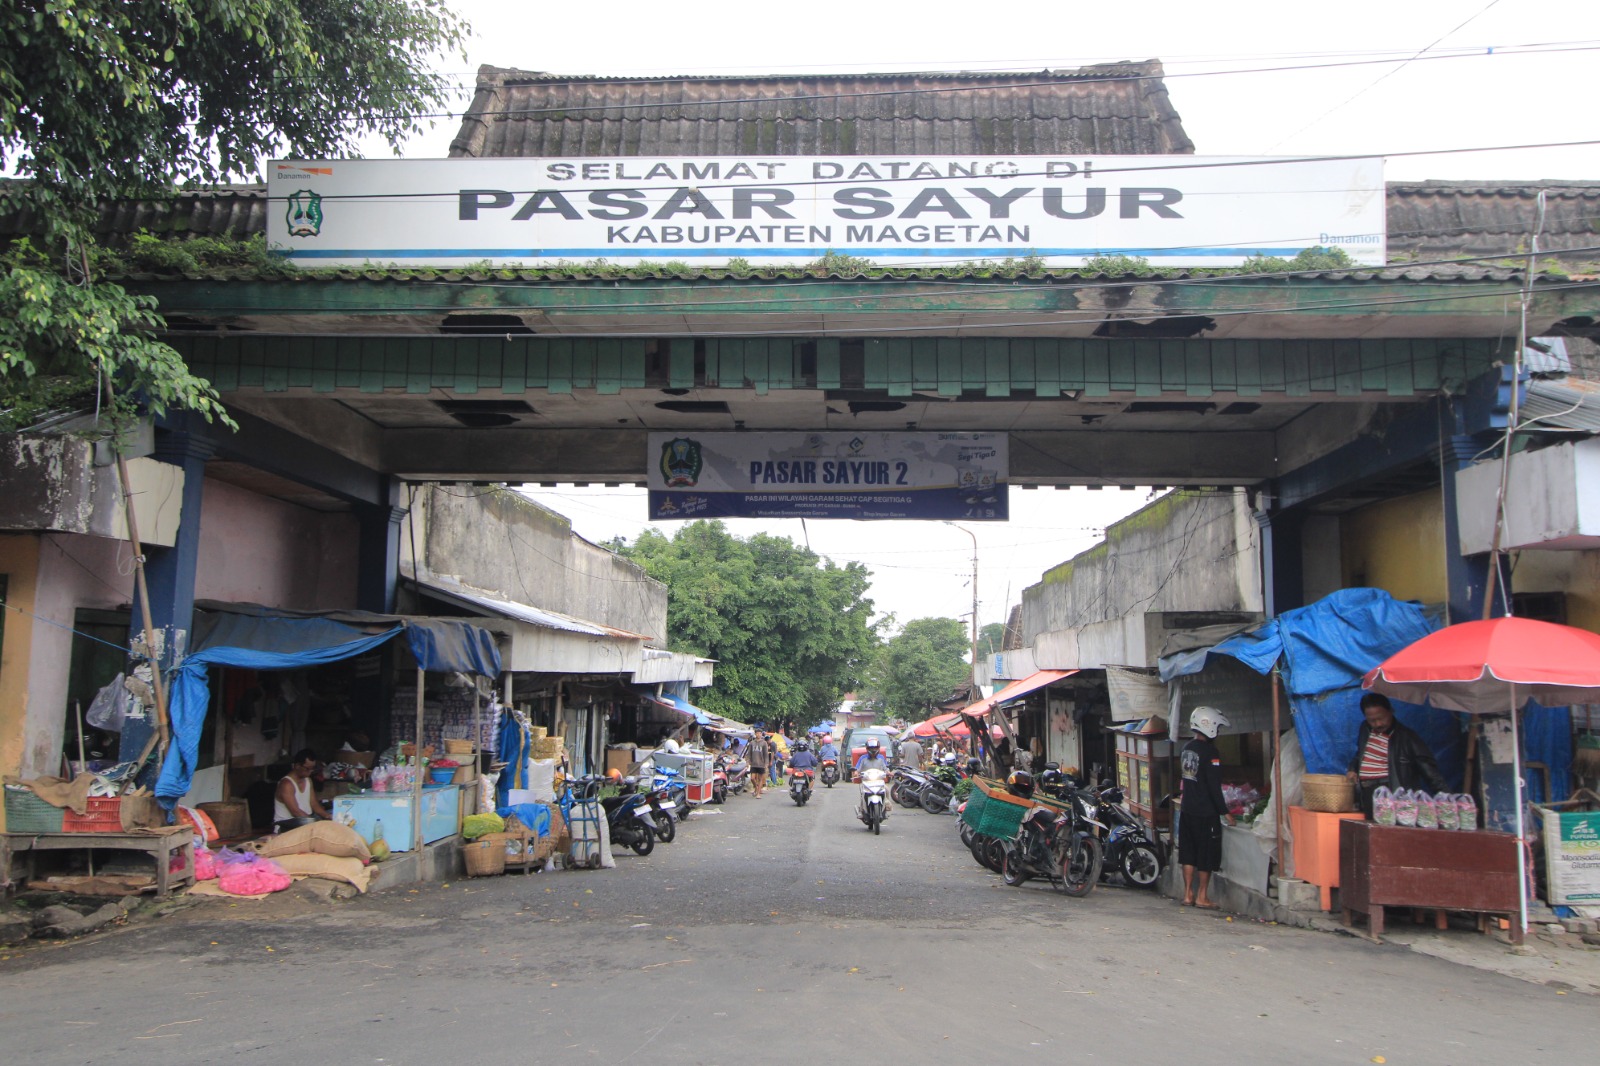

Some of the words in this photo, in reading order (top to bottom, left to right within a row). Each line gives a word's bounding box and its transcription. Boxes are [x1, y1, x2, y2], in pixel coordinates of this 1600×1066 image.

[547, 162, 785, 181] SELAMAT
[813, 161, 1019, 179] DATANG
[1046, 161, 1092, 179] DI
[459, 188, 796, 220] PASAR
[833, 187, 1185, 219] SAYUR
[607, 226, 831, 244] KABUPATEN
[846, 225, 1030, 243] MAGETAN
[1320, 233, 1380, 244] Danamon
[751, 461, 817, 485] PASAR
[822, 461, 889, 485] SAYUR
[896, 461, 909, 485] 2
